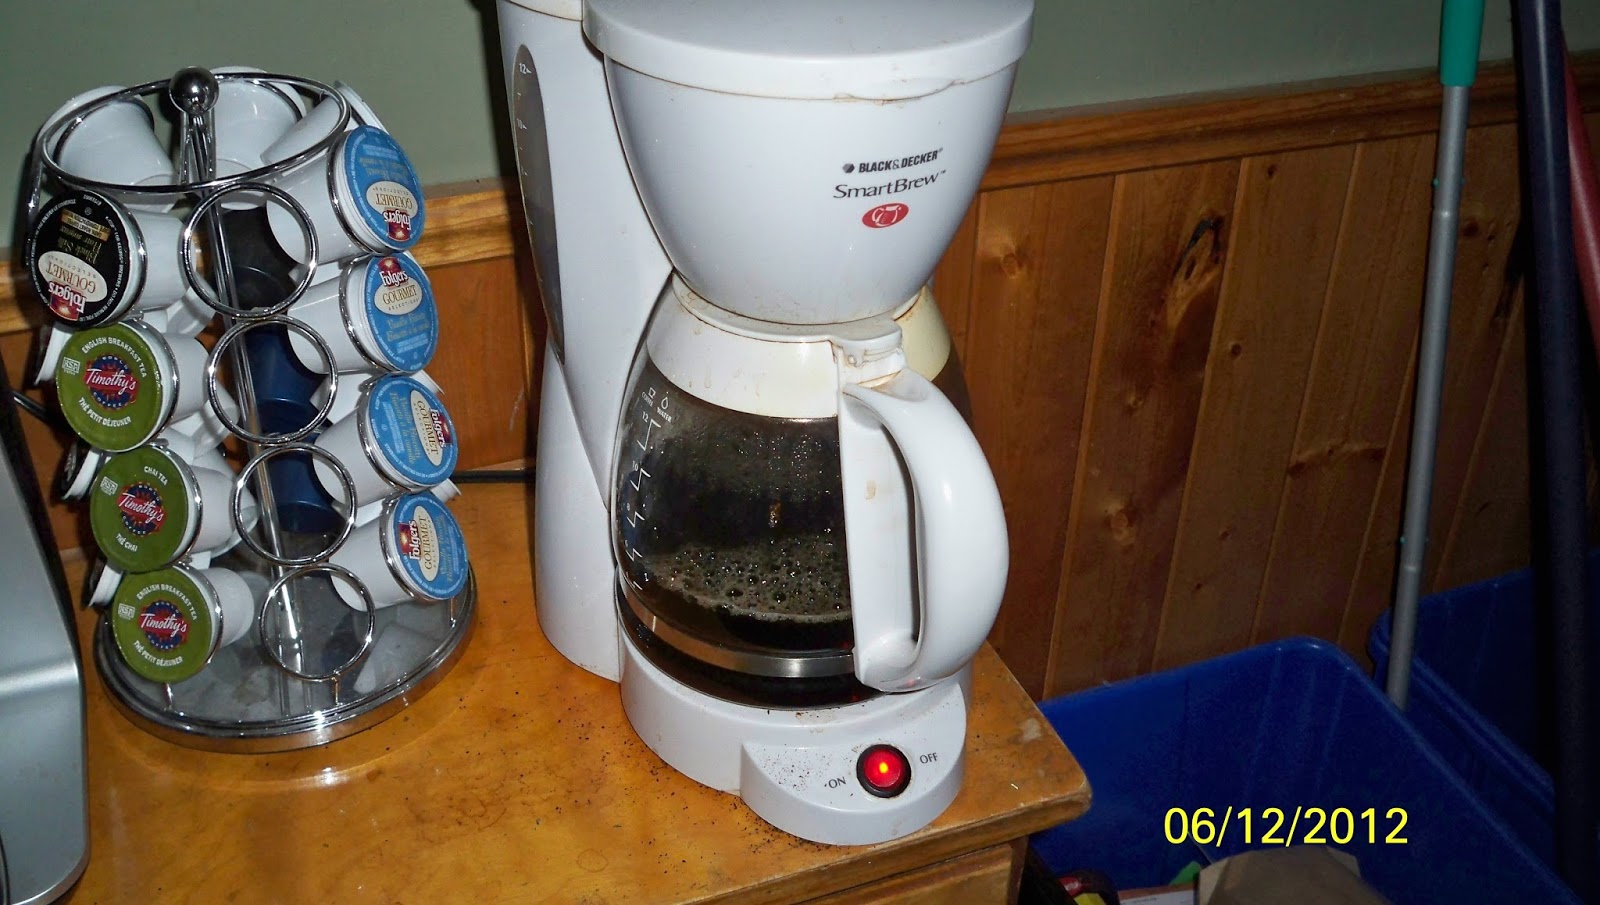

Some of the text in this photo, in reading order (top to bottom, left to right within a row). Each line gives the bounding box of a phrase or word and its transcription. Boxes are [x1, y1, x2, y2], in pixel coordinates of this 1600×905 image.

[833, 172, 939, 198] SmartBrew
[375, 193, 413, 209] GOURMET
[383, 209, 411, 230] Folgers
[46, 262, 96, 294] GOURMET
[379, 270, 408, 286] Folgers
[48, 281, 87, 314] Folgers
[383, 285, 417, 304] GOURMET
[82, 337, 147, 378] ENGLISH BREAKFAST TEA
[86, 368, 136, 395] Timothy's
[87, 409, 102, 423] PETIT
[642, 411, 649, 422] 12
[657, 406, 672, 422] WATER
[417, 400, 438, 455] GOURMET
[430, 408, 446, 448] Folgers
[143, 466, 168, 485] CHAI TEA
[119, 493, 164, 523] Timothy's
[124, 542, 138, 552] CHAI
[409, 520, 421, 560] Folgers
[419, 515, 432, 569] GOURMET
[136, 584, 197, 620] ENGLISH BREAKFAST TEA
[141, 613, 187, 637] Timothy's
[141, 650, 156, 663] PETIT
[919, 752, 938, 764] OFF
[828, 776, 847, 789] ON
